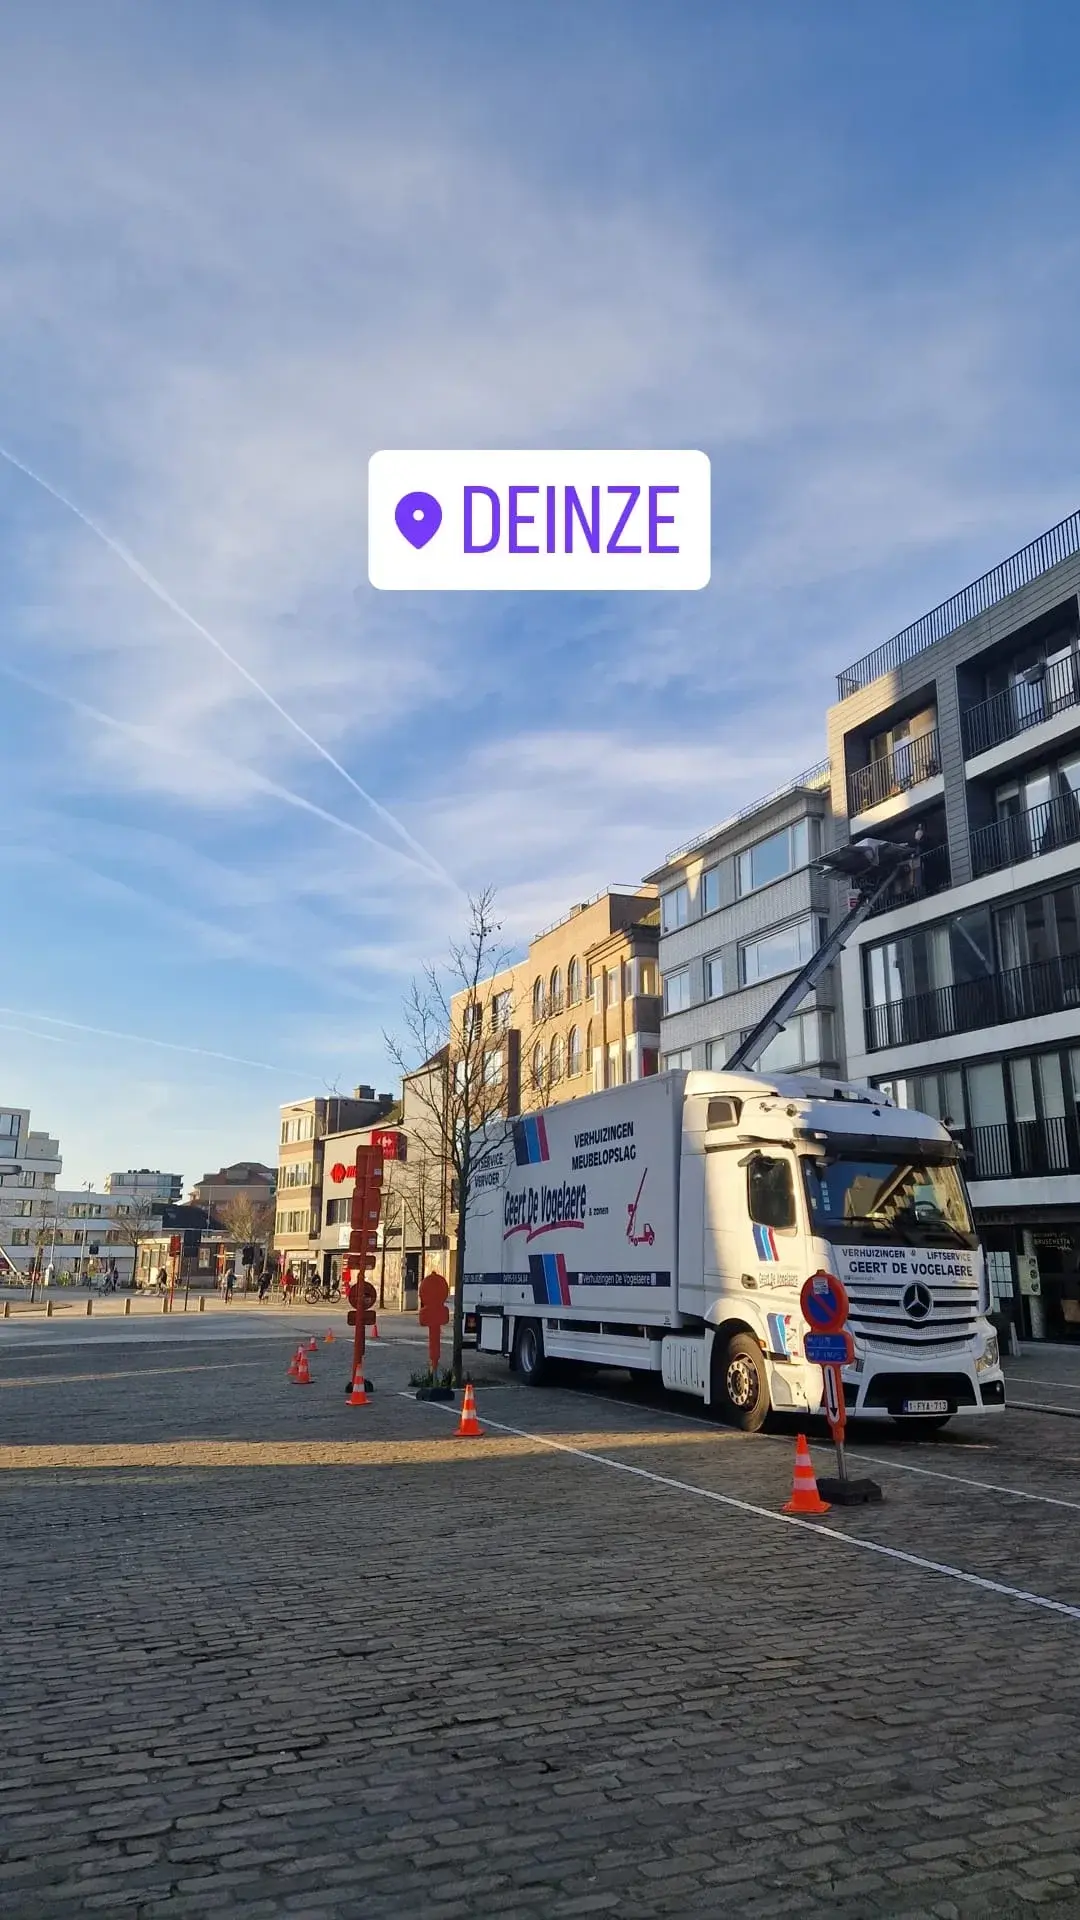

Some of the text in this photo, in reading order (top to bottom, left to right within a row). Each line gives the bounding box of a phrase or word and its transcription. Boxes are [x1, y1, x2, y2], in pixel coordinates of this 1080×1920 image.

[574, 1121, 634, 1149] VERHUIZINGEN
[571, 1144, 637, 1171] MEUBELOPSLAG
[474, 1172, 500, 1188] VERVOER
[504, 1186, 527, 1226] Geert
[527, 1187, 539, 1224] De
[541, 1180, 587, 1225] Vogelaere
[593, 1206, 609, 1216] zonen
[842, 1247, 905, 1259] VERHUIZINGEN
[926, 1251, 972, 1262] LIFTSERVICE
[849, 1261, 973, 1277] GEERT DE VOGELAERE
[615, 1273, 623, 1285] De
[623, 1273, 651, 1287] Vogelaere
